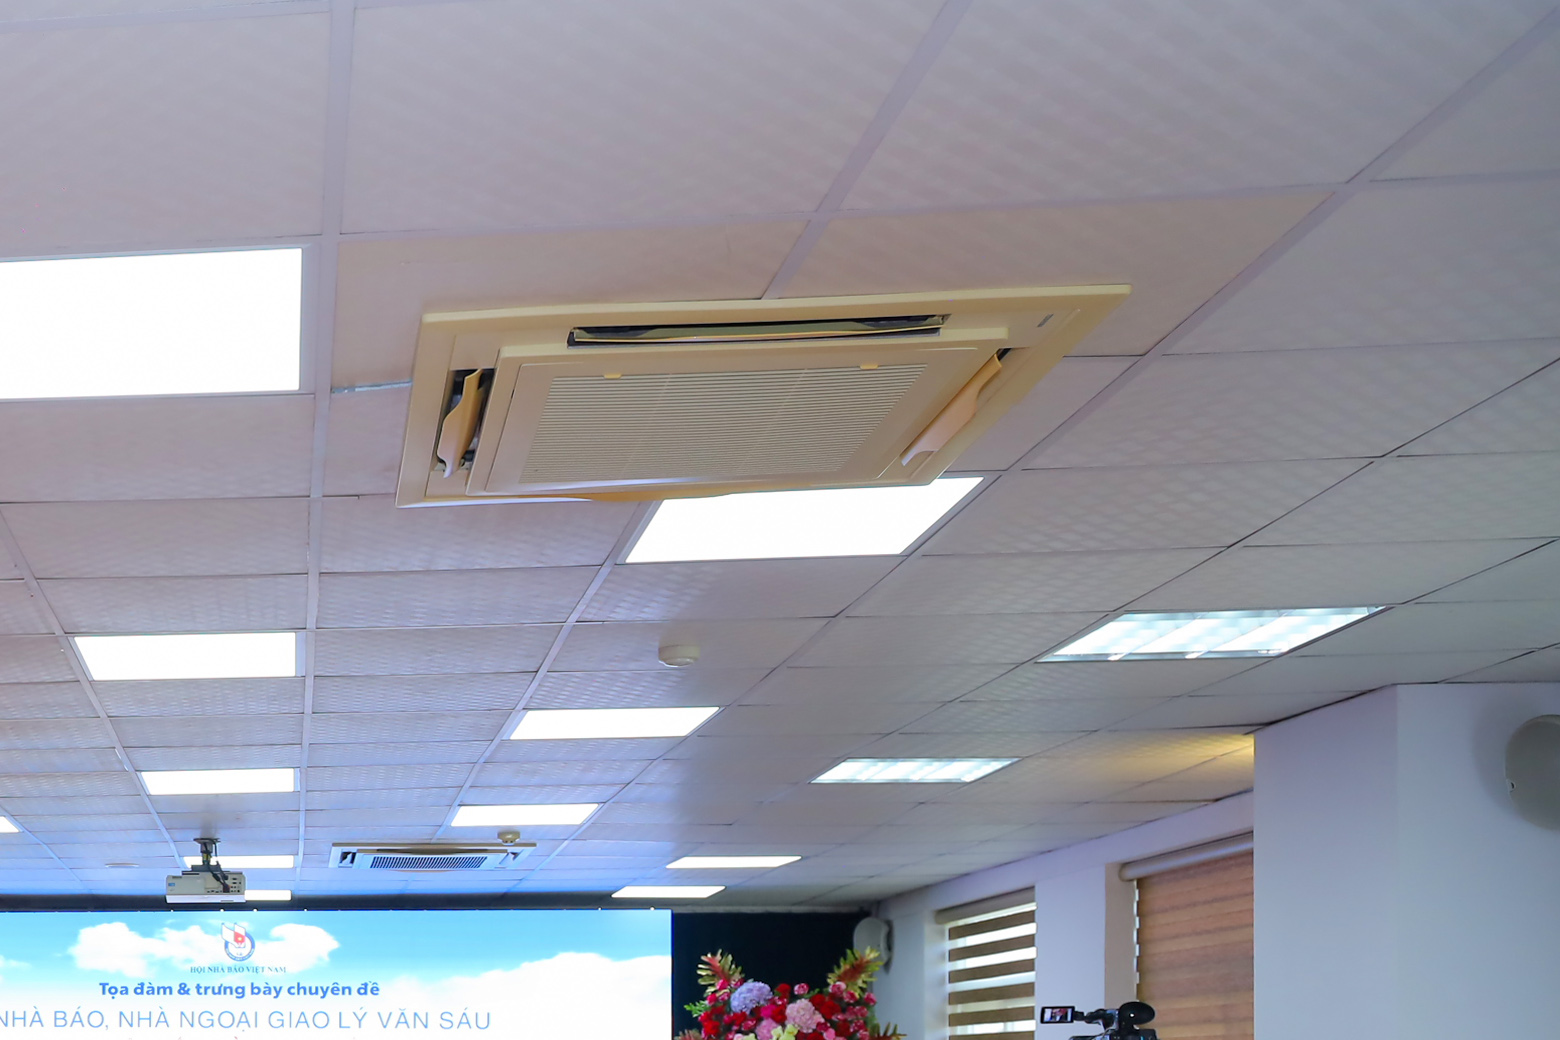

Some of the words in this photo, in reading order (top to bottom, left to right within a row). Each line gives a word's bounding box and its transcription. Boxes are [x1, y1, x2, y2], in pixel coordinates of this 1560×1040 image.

[190, 966, 205, 975] HỘI
[207, 964, 225, 973] NHÀ
[227, 964, 244, 974] BÁO
[246, 965, 265, 975] VIỆT
[99, 982, 129, 999] Tọa
[133, 982, 173, 996] đàm
[177, 982, 191, 996] &
[195, 983, 246, 999] trưng
[250, 982, 283, 999] bày
[287, 982, 352, 999] chuyên
[356, 980, 380, 996] đề
[53, 1006, 109, 1030] BÁO,
[119, 1006, 170, 1028] NHÀ
[180, 1010, 258, 1032] NGOẠI
[268, 1010, 330, 1029] GIAO
[338, 1006, 368, 1029] LÝ
[377, 1008, 429, 1029] VĂN
[439, 1006, 490, 1030] SÁU
